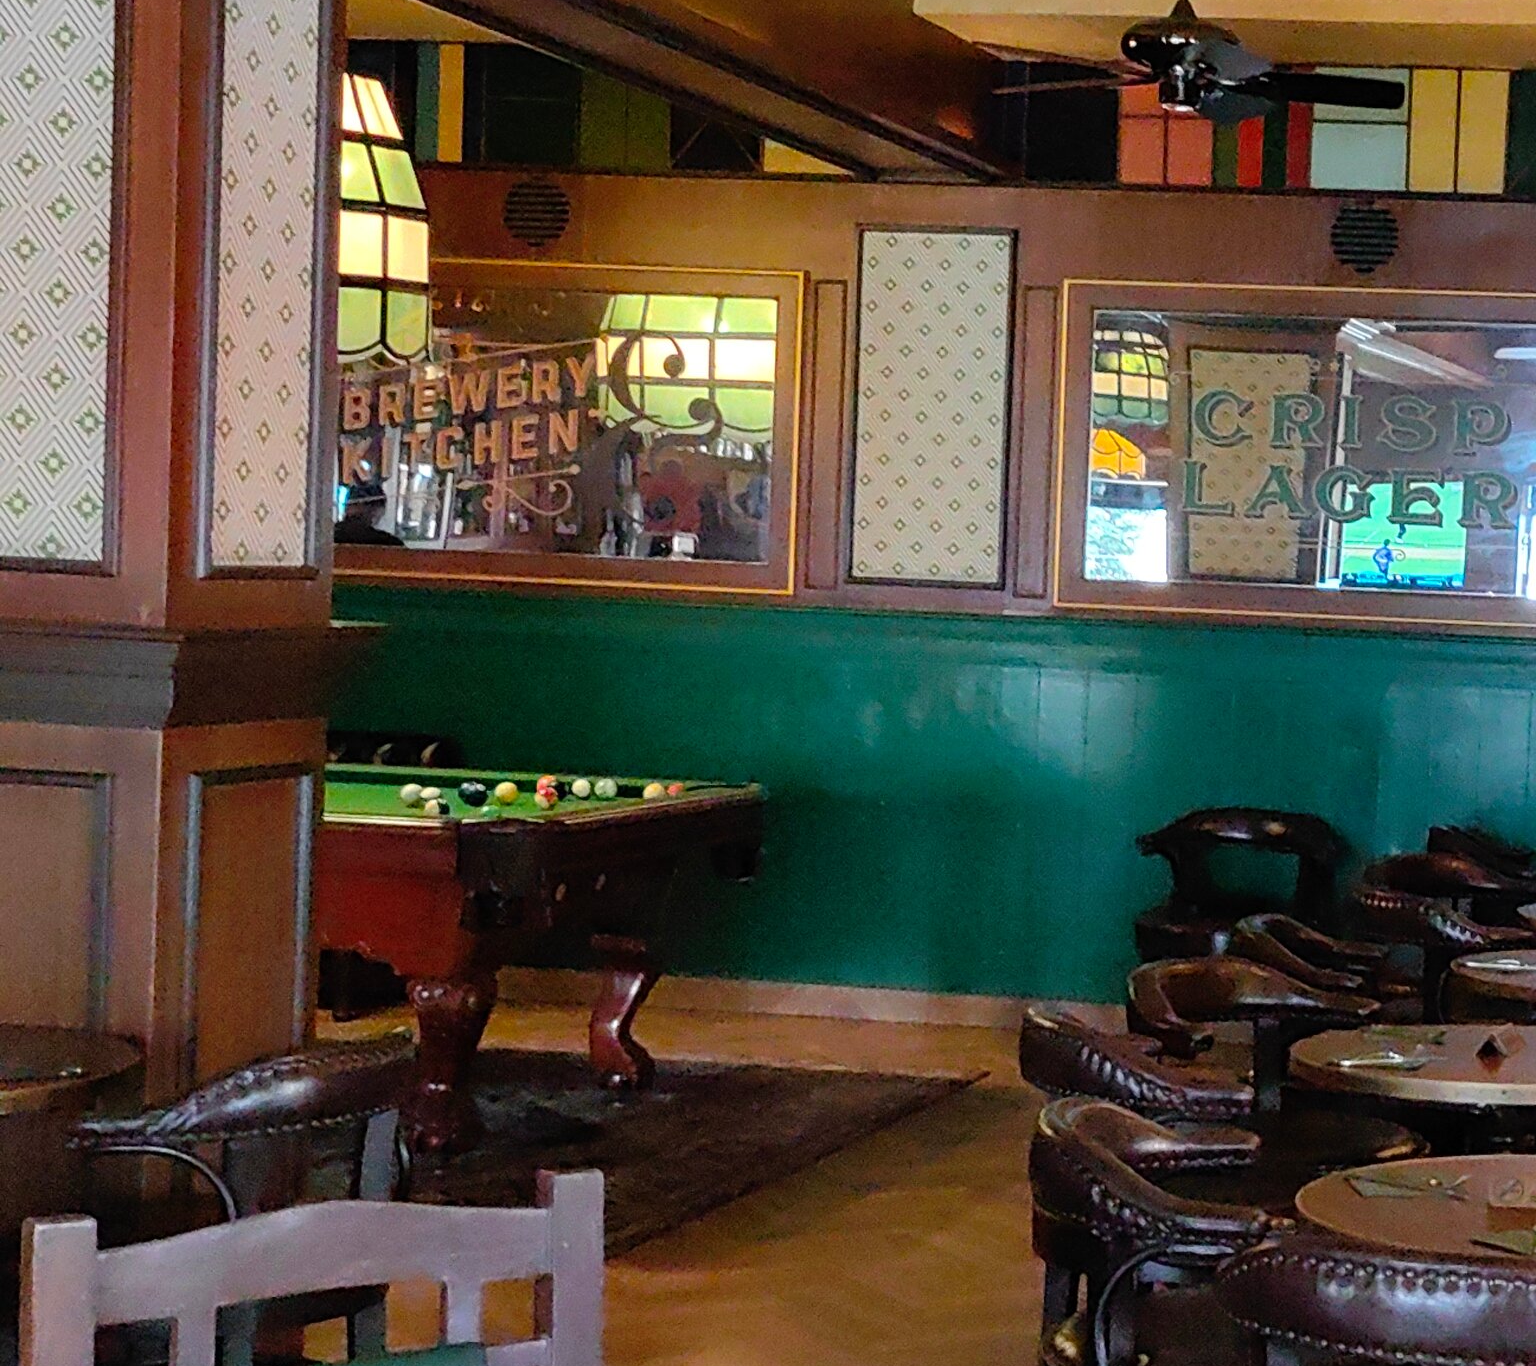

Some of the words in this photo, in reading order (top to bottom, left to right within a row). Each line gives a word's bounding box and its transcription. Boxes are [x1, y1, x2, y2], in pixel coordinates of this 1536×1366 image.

[343, 355, 595, 431] BREWERY
[1193, 390, 1512, 457] CRISP
[341, 408, 580, 485] KITCHEN
[1183, 460, 1519, 529] LAGER
